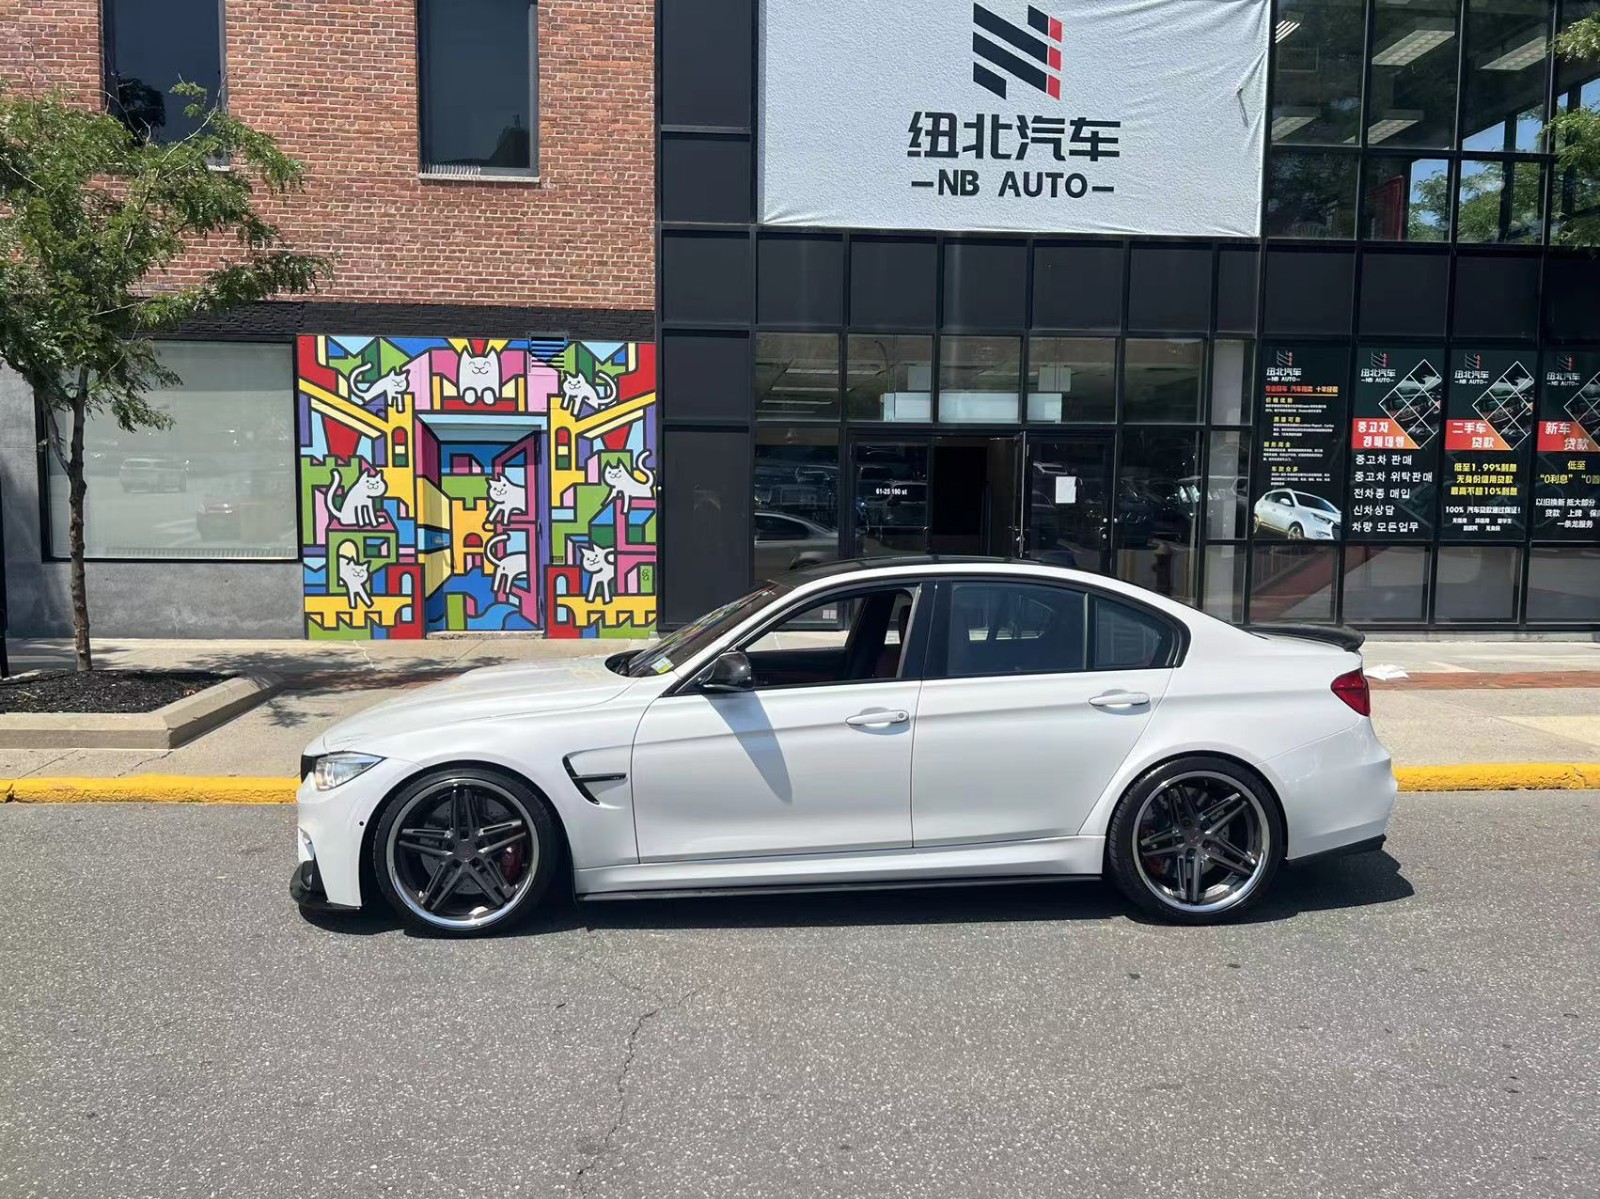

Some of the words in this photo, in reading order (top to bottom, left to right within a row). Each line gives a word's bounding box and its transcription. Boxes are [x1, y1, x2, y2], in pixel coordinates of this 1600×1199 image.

[907, 111, 1121, 162] 纽北汽车
[1266, 367, 1302, 376] 纽北汽车
[1360, 368, 1396, 377] 纽北汽车
[1454, 370, 1490, 379] 纽北汽车
[1547, 372, 1581, 381] 纽北汽车
[1358, 421, 1389, 433] 중고차
[1452, 422, 1486, 434] 二手车
[1545, 422, 1571, 435] 新车
[1471, 436, 1494, 448] 贷款
[1564, 437, 1589, 451] 贷款
[1355, 454, 1387, 466] 중고차
[1391, 455, 1412, 466] 판매
[1567, 460, 1586, 471] 低至
[1354, 471, 1386, 483] 중고차
[1390, 471, 1433, 483] 위탁판매
[1353, 488, 1385, 499] 전차종
[1389, 488, 1410, 499] 매입
[1535, 498, 1565, 507] 以旧换新
[1353, 505, 1395, 516] 신차상담
[1445, 506, 1464, 514] 100%
[1545, 509, 1560, 517] 贷款
[1352, 522, 1373, 533] 차량
[1376, 522, 1419, 533] 모든업무
